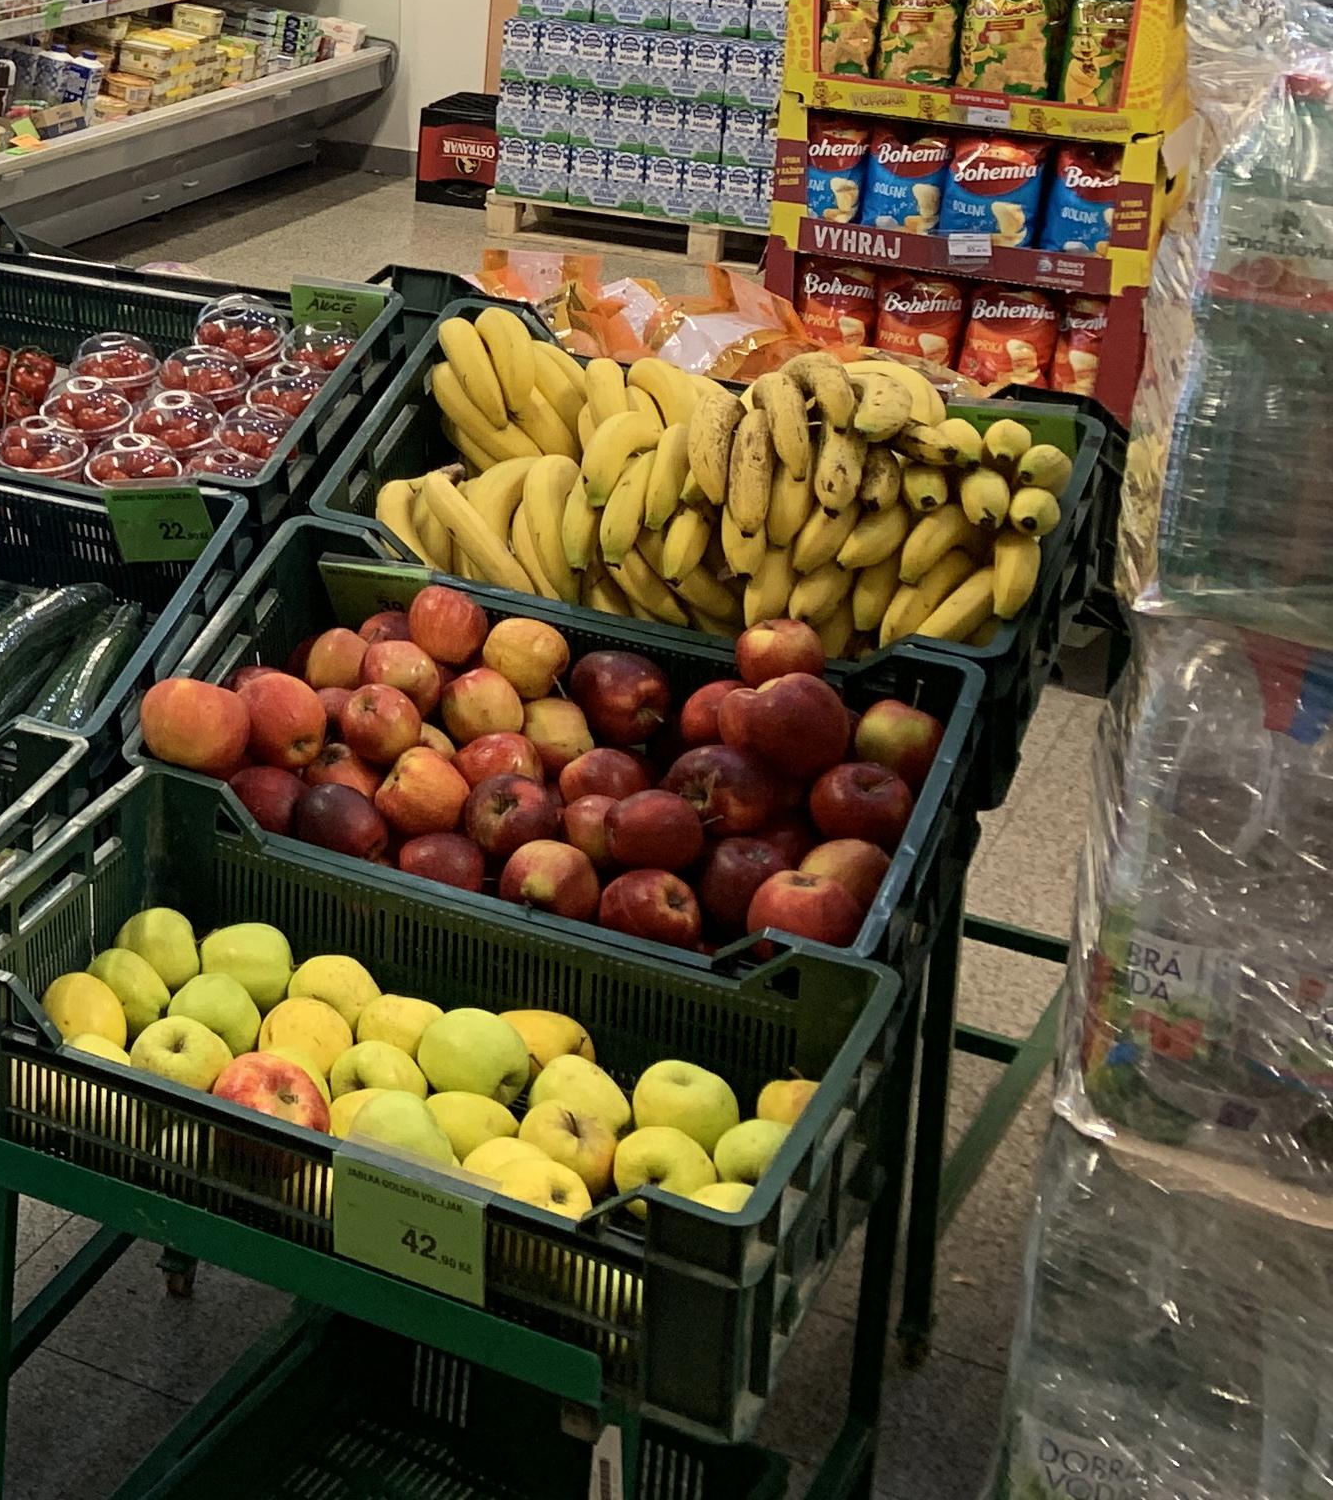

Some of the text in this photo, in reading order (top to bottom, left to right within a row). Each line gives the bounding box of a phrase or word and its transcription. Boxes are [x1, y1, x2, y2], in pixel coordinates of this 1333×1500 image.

[443, 139, 495, 160] OSTRAVAR
[809, 141, 869, 159] ohemi
[873, 181, 908, 199] SOLENÉ
[813, 224, 902, 259] VYHRAJ
[884, 291, 962, 314] Bohemia
[972, 298, 1056, 321] Bohemia
[158, 522, 184, 541] 22
[381, 1180, 421, 1200] GOLDEN
